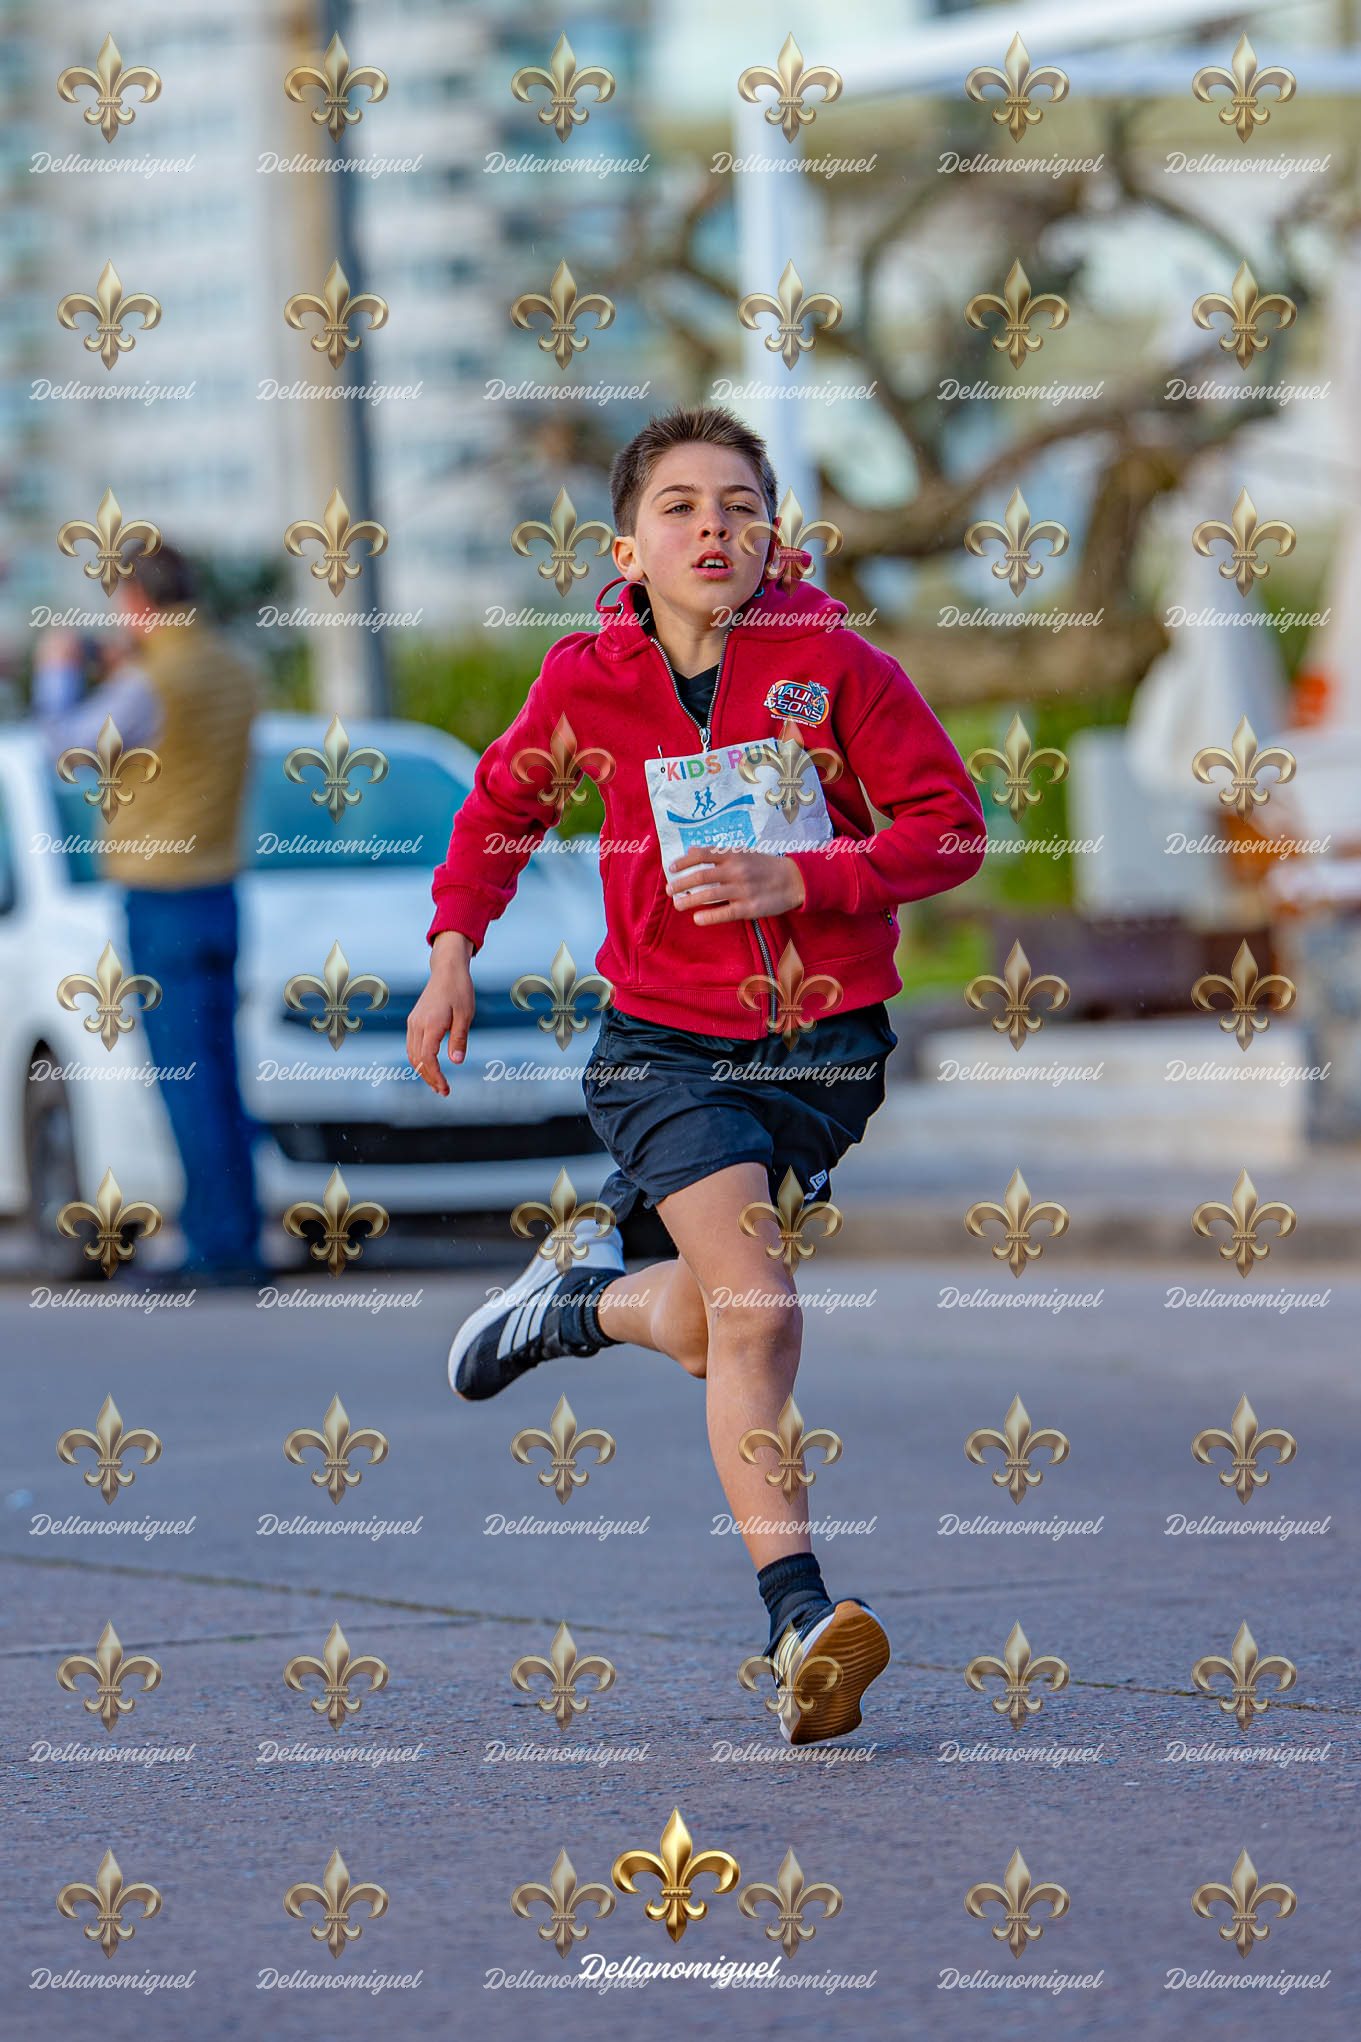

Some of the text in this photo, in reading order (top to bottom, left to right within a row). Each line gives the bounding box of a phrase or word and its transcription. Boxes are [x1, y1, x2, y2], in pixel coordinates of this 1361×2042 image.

[768, 684, 812, 703] MAUI
[667, 741, 781, 782] KIDS RUN
